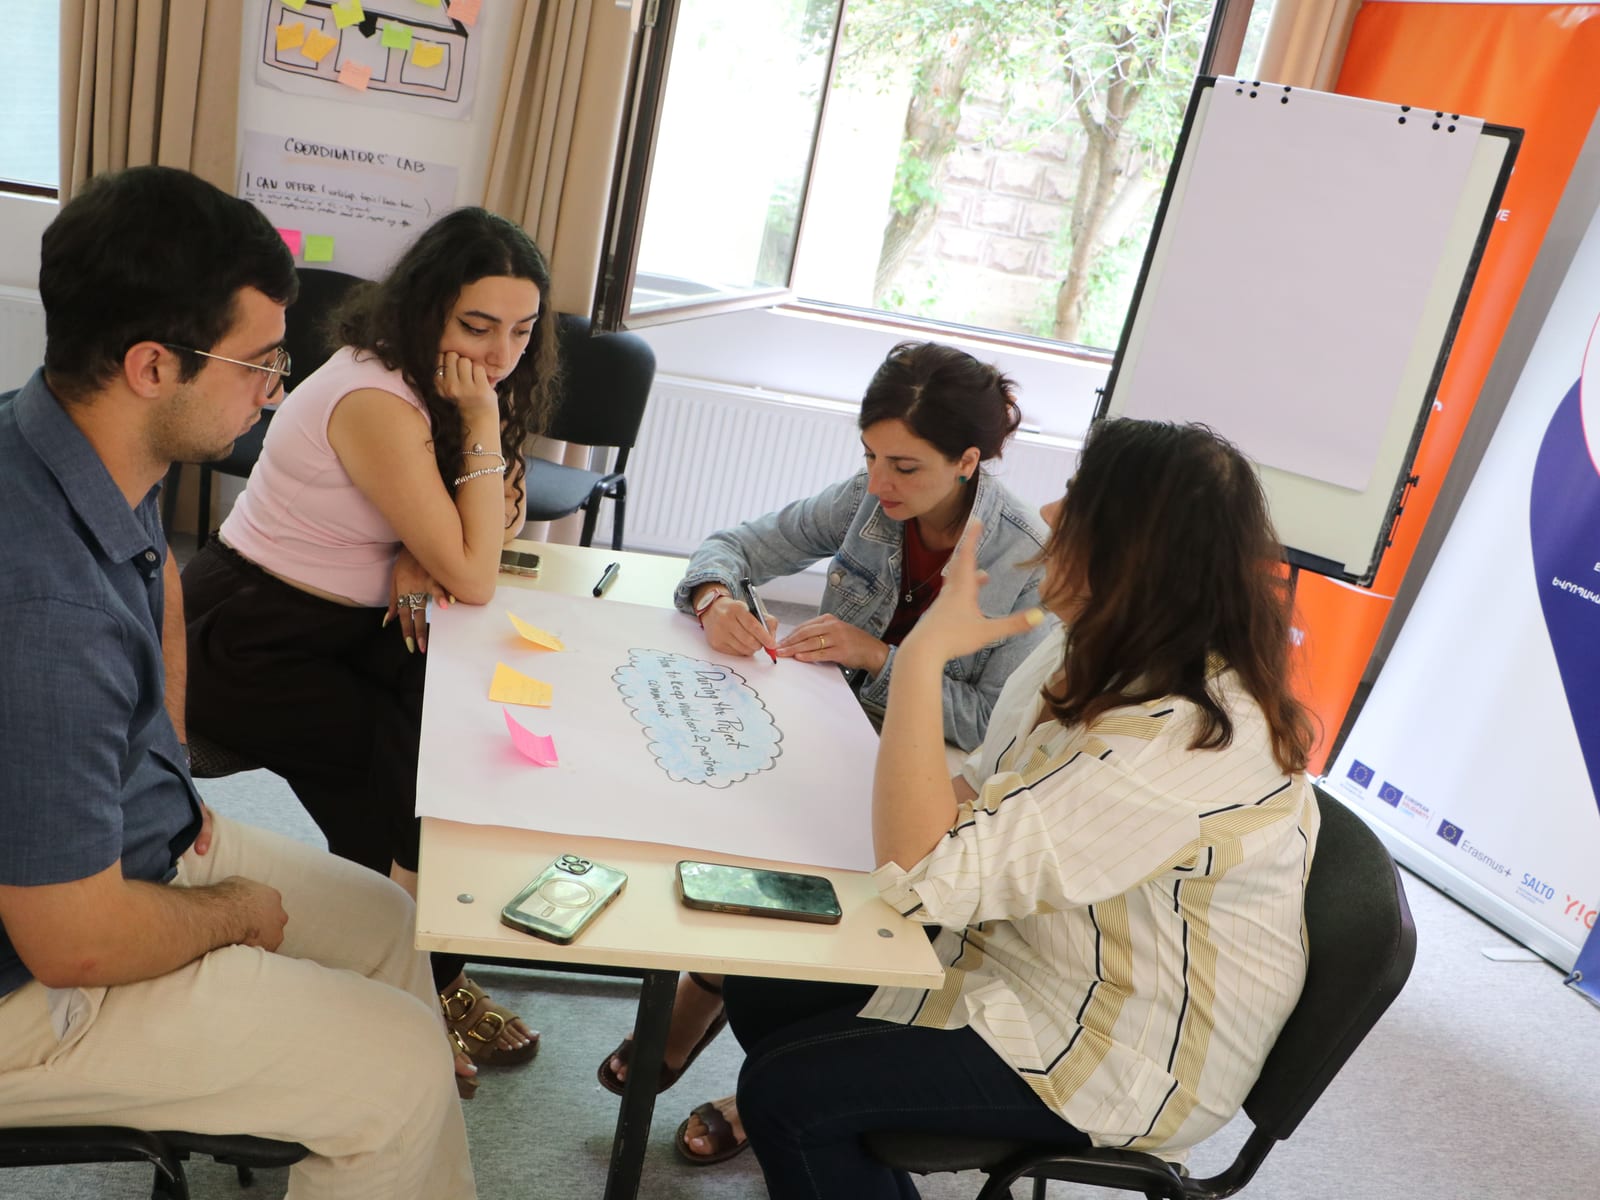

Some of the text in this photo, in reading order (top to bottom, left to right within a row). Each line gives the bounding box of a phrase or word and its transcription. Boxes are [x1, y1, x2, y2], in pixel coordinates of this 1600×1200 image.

[396, 157, 426, 173] LAB
[256, 176, 278, 189] CAN
[285, 181, 317, 193] OFFER
[693, 670, 750, 750] During the Project
[1460, 839, 1513, 878] Erasmus+
[1520, 873, 1556, 900] SALTO
